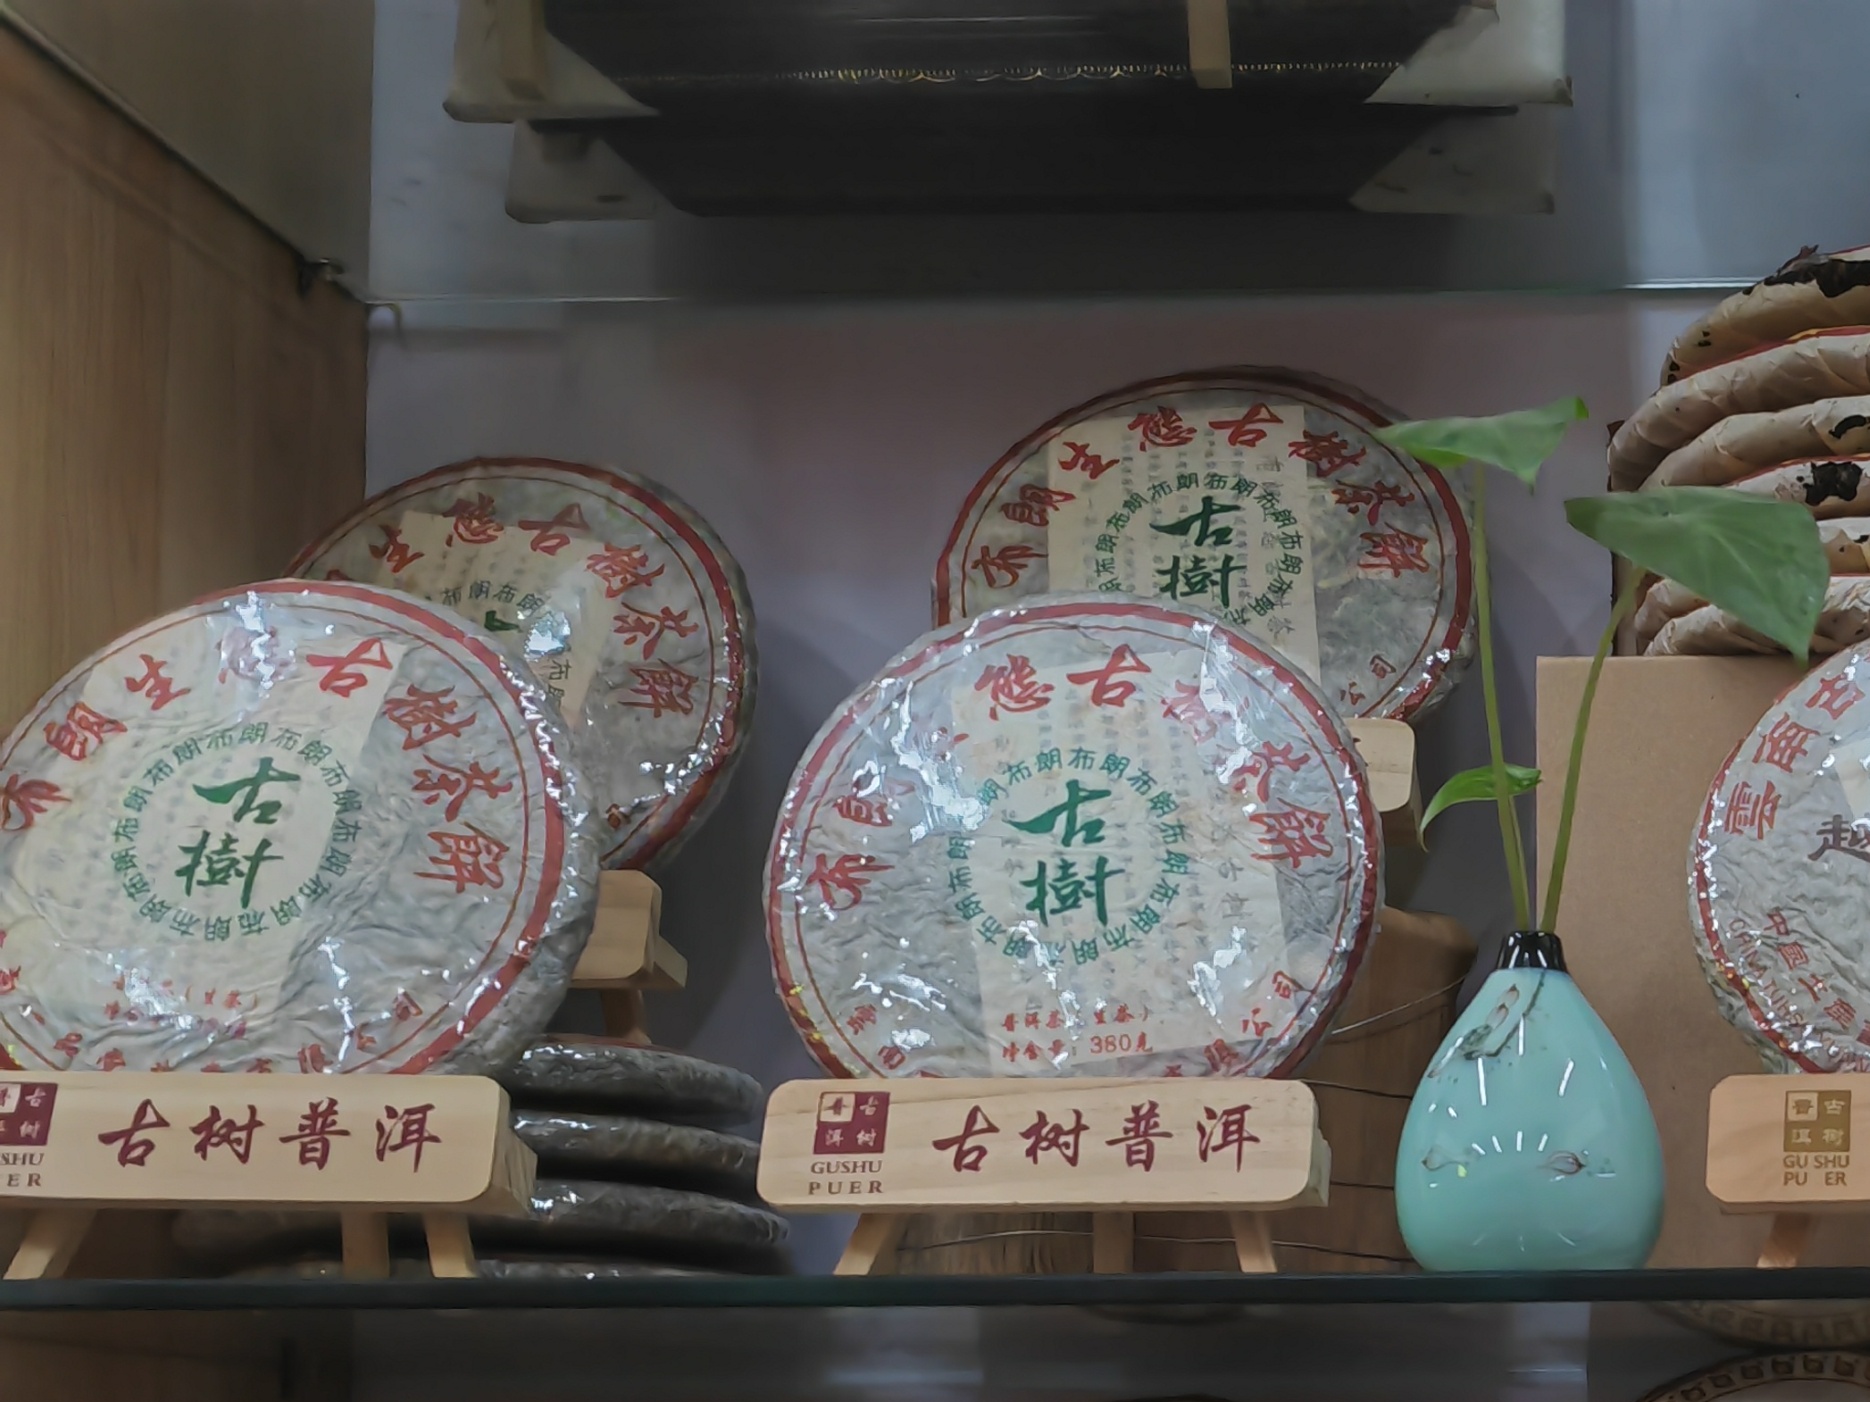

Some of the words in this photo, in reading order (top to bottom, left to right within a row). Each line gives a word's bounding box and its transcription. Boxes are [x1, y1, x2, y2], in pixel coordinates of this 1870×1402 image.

[1150, 496, 1246, 608] 古樹
[173, 757, 302, 908] 古樹
[1003, 779, 1126, 927] 古樹
[98, 1098, 442, 1174] 古树普洱
[811, 1160, 883, 1175] GUSHU
[932, 1100, 1261, 1173] 古树普洱
[1783, 1155, 1809, 1169] GU
[1814, 1155, 1850, 1169] SHU
[808, 1180, 884, 1196] PUER
[1783, 1172, 1807, 1186] PU
[1825, 1172, 1847, 1186] ER
